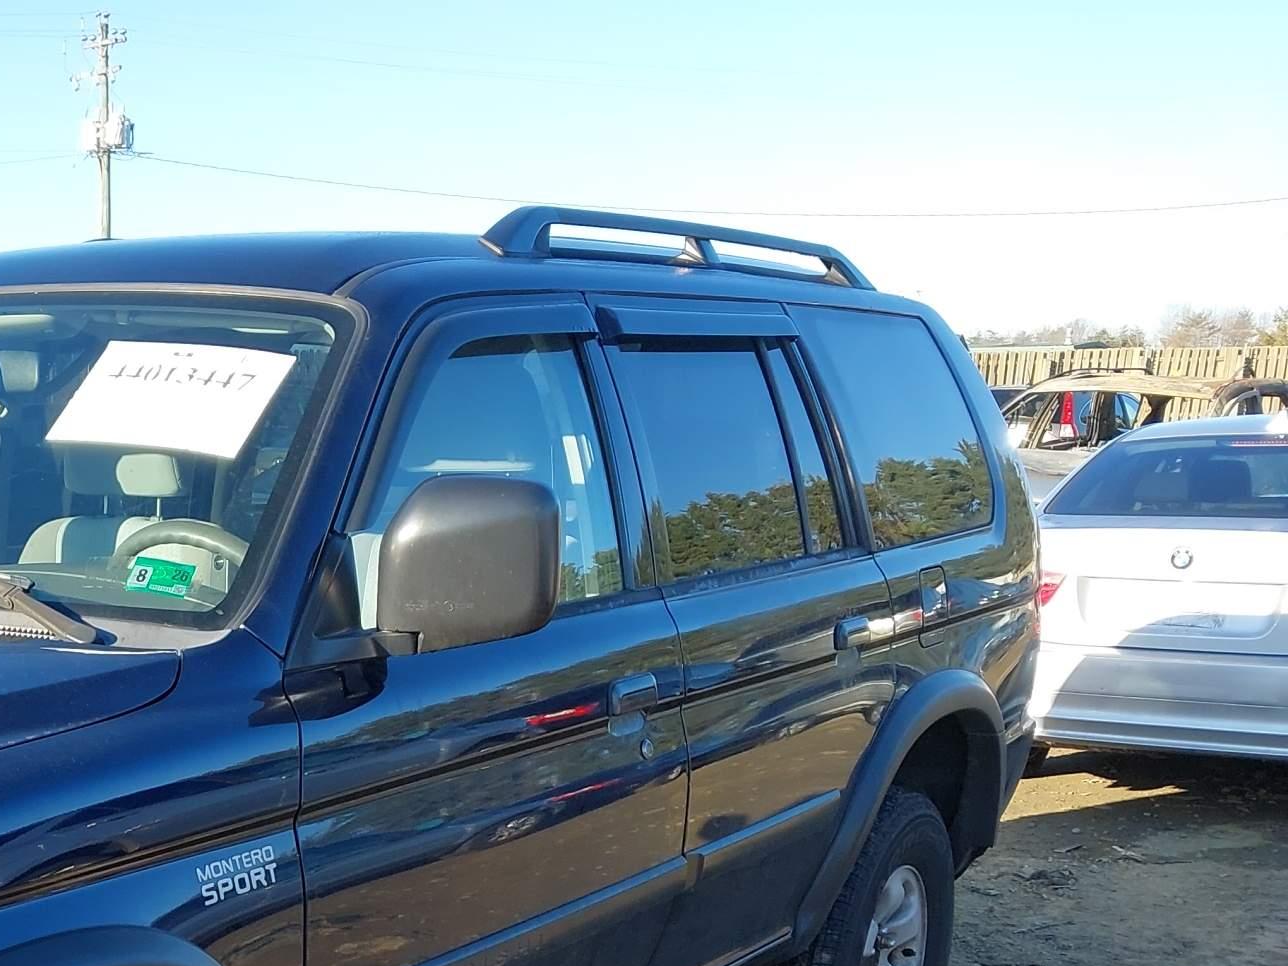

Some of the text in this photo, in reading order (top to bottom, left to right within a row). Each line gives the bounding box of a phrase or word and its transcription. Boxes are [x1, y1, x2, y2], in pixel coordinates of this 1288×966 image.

[135, 568, 190, 583] 8 26
[196, 845, 275, 882] MONTERO
[201, 862, 278, 906] SPORT
